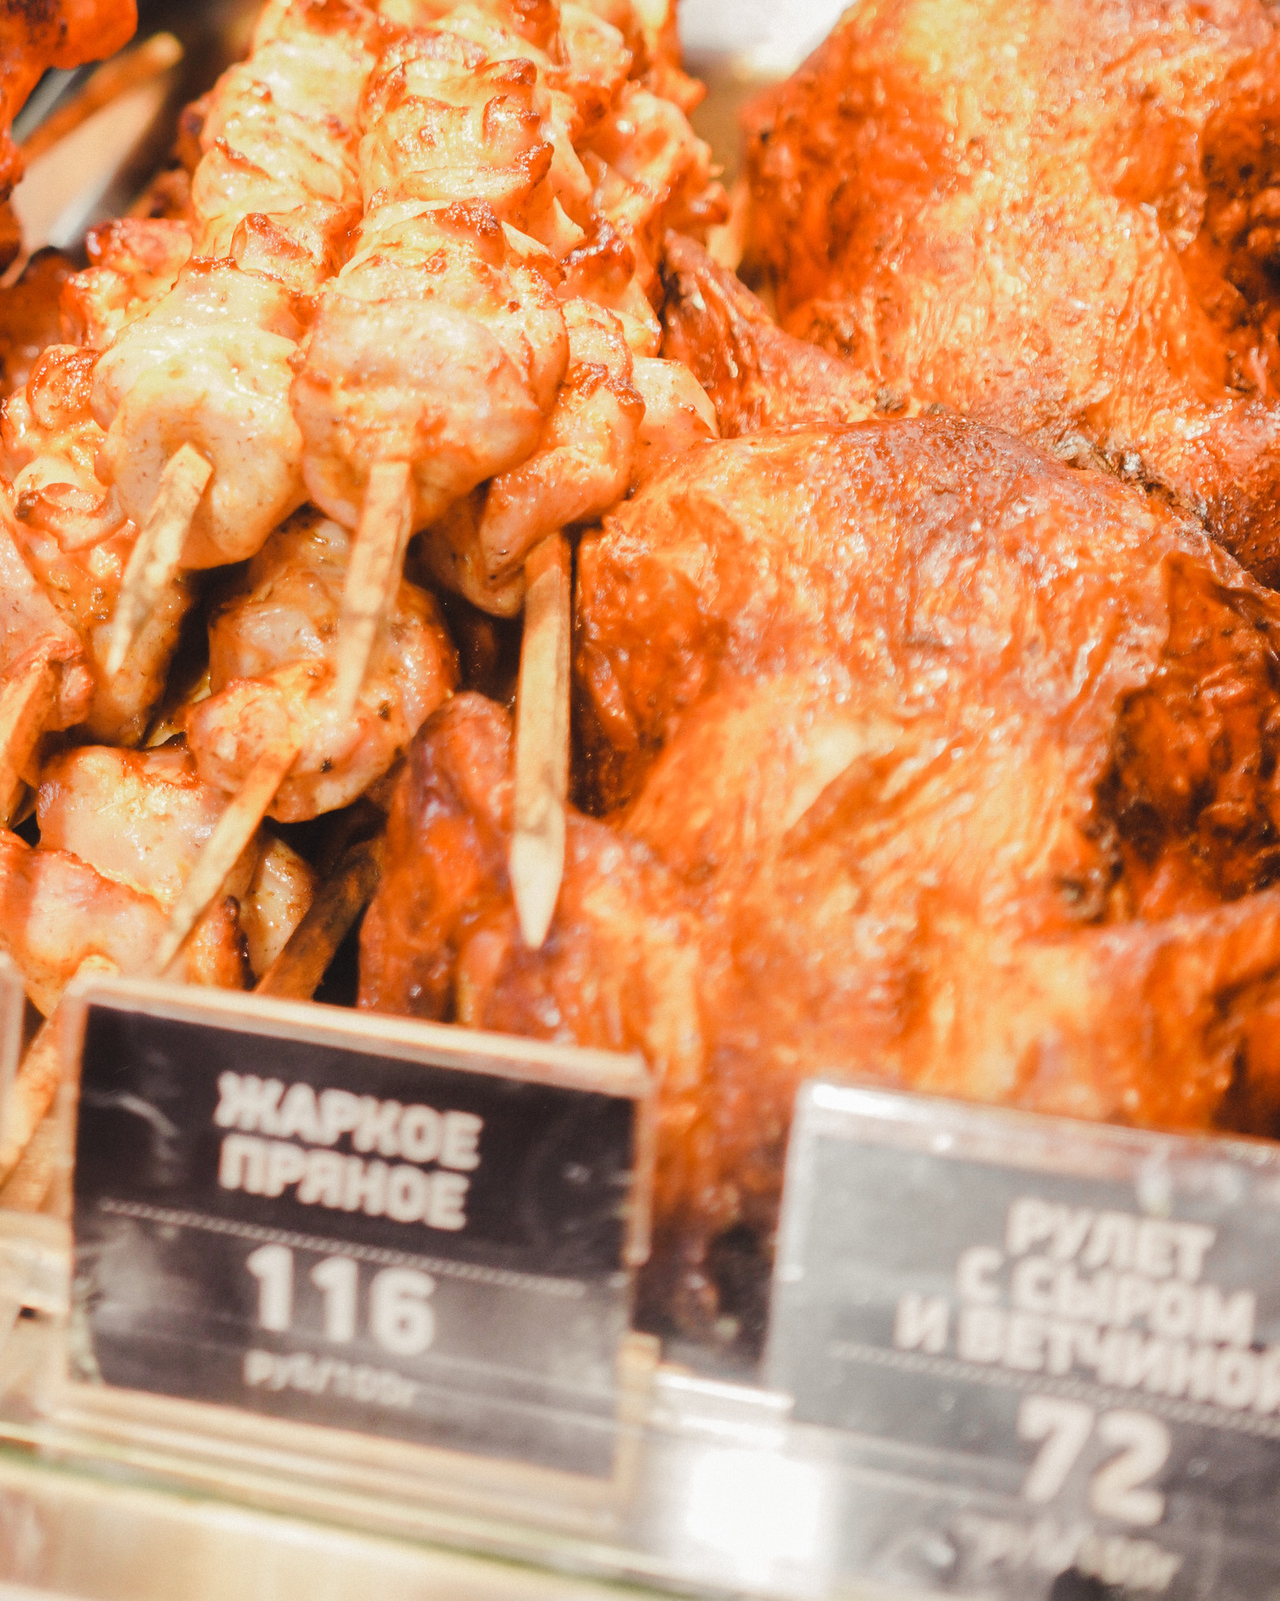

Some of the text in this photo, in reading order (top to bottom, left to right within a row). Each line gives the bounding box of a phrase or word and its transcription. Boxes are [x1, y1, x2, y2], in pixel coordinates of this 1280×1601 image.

[215, 1071, 484, 1171] ЖАРКОЕ
[219, 1134, 472, 1231] ПРЯНОЕ
[1006, 1197, 1218, 1281] РУЛЕТ
[246, 1243, 437, 1356] 116
[894, 1296, 950, 1354] И
[957, 1245, 1258, 1347] С СЫРОМ
[1020, 1398, 1170, 1526] 72
